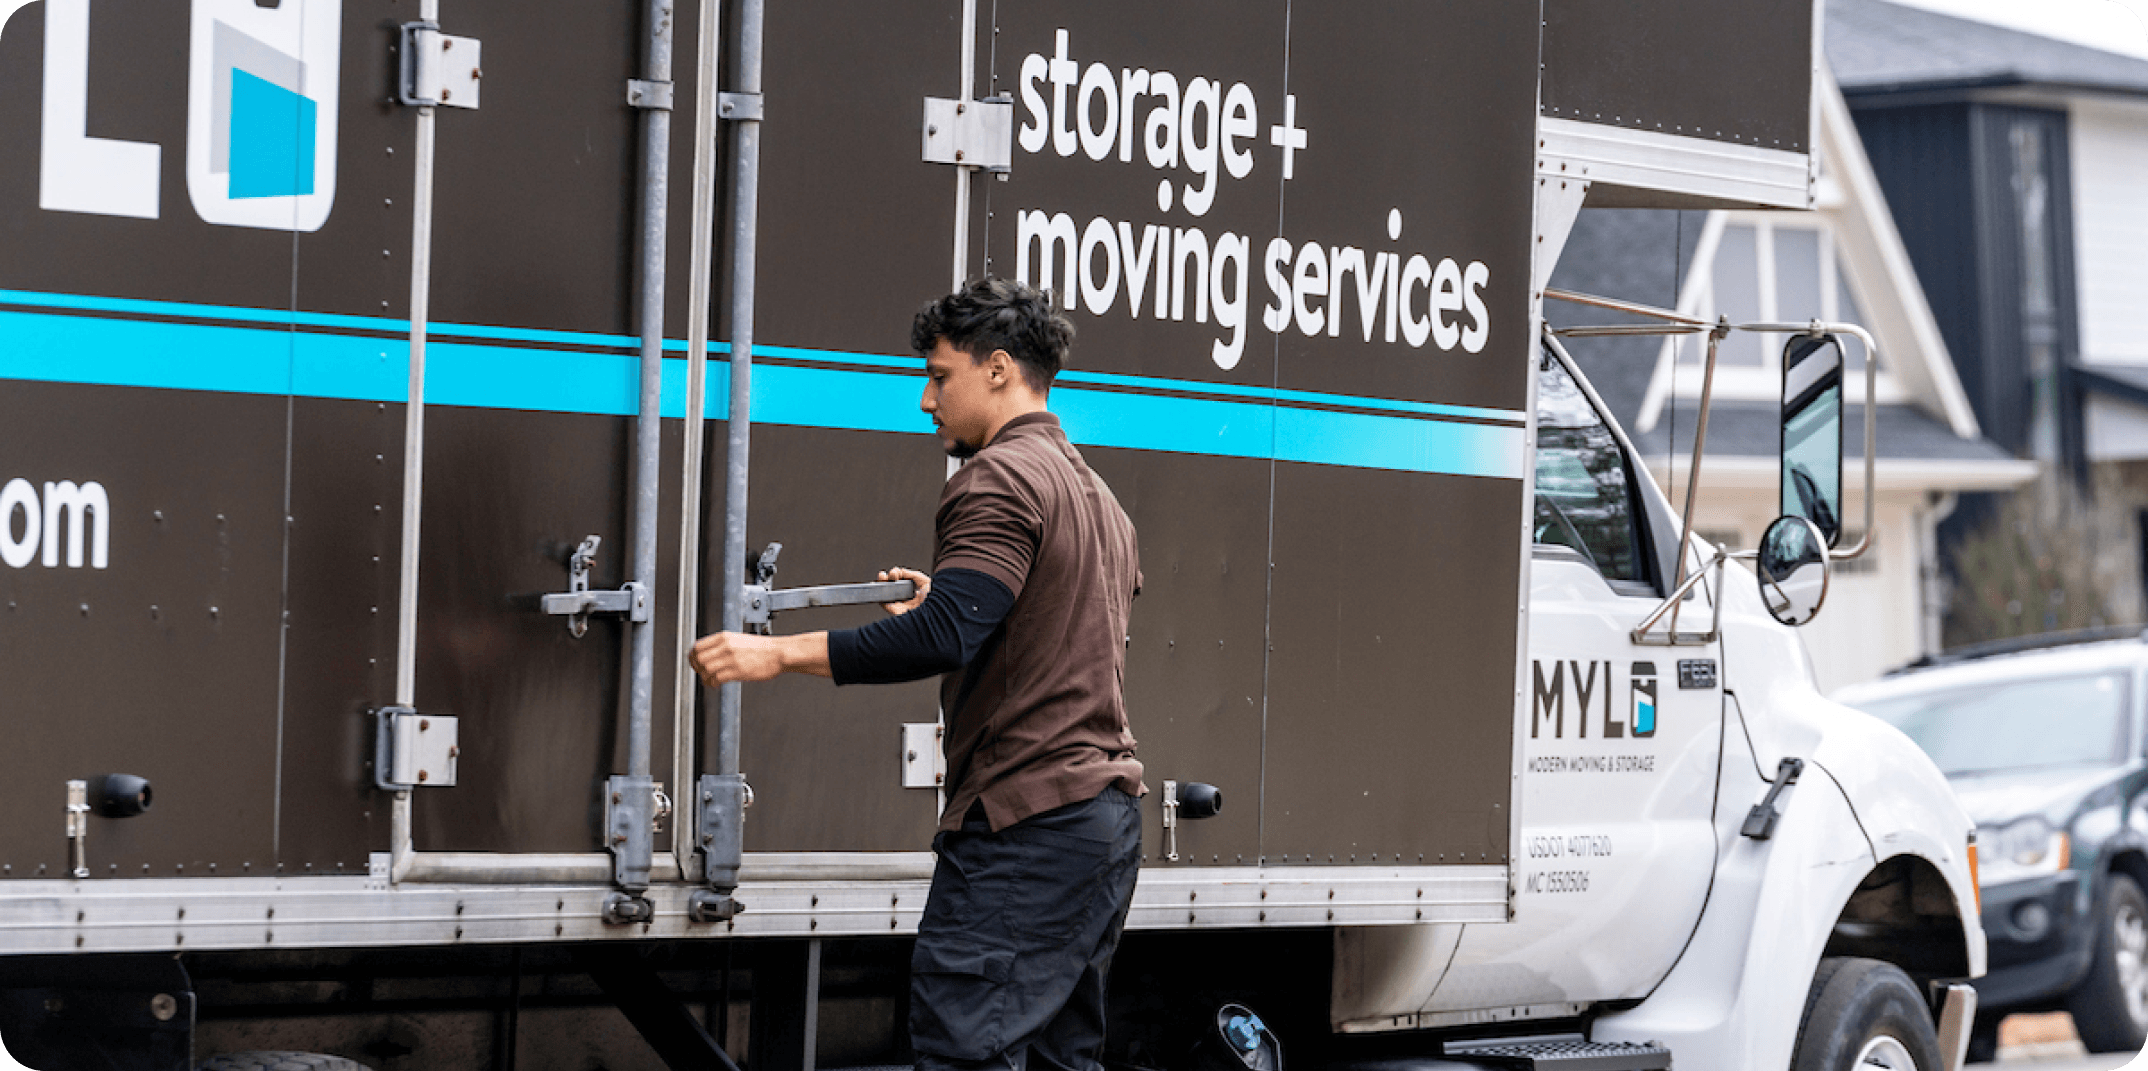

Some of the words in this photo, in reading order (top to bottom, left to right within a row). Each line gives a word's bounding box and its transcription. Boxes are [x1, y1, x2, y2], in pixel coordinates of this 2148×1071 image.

[1018, 28, 1258, 216] storage
[1016, 179, 1250, 370] moving
[1263, 207, 1490, 353] services
[0, 477, 109, 569] om
[1531, 659, 1657, 738] MYLO
[1527, 755, 1567, 773] MODERN
[1569, 755, 1604, 773] MOVING
[1606, 755, 1613, 773] &
[1616, 755, 1655, 773] STORAGE
[1525, 872, 1545, 894] MC
[1527, 835, 1565, 858] USDOT
